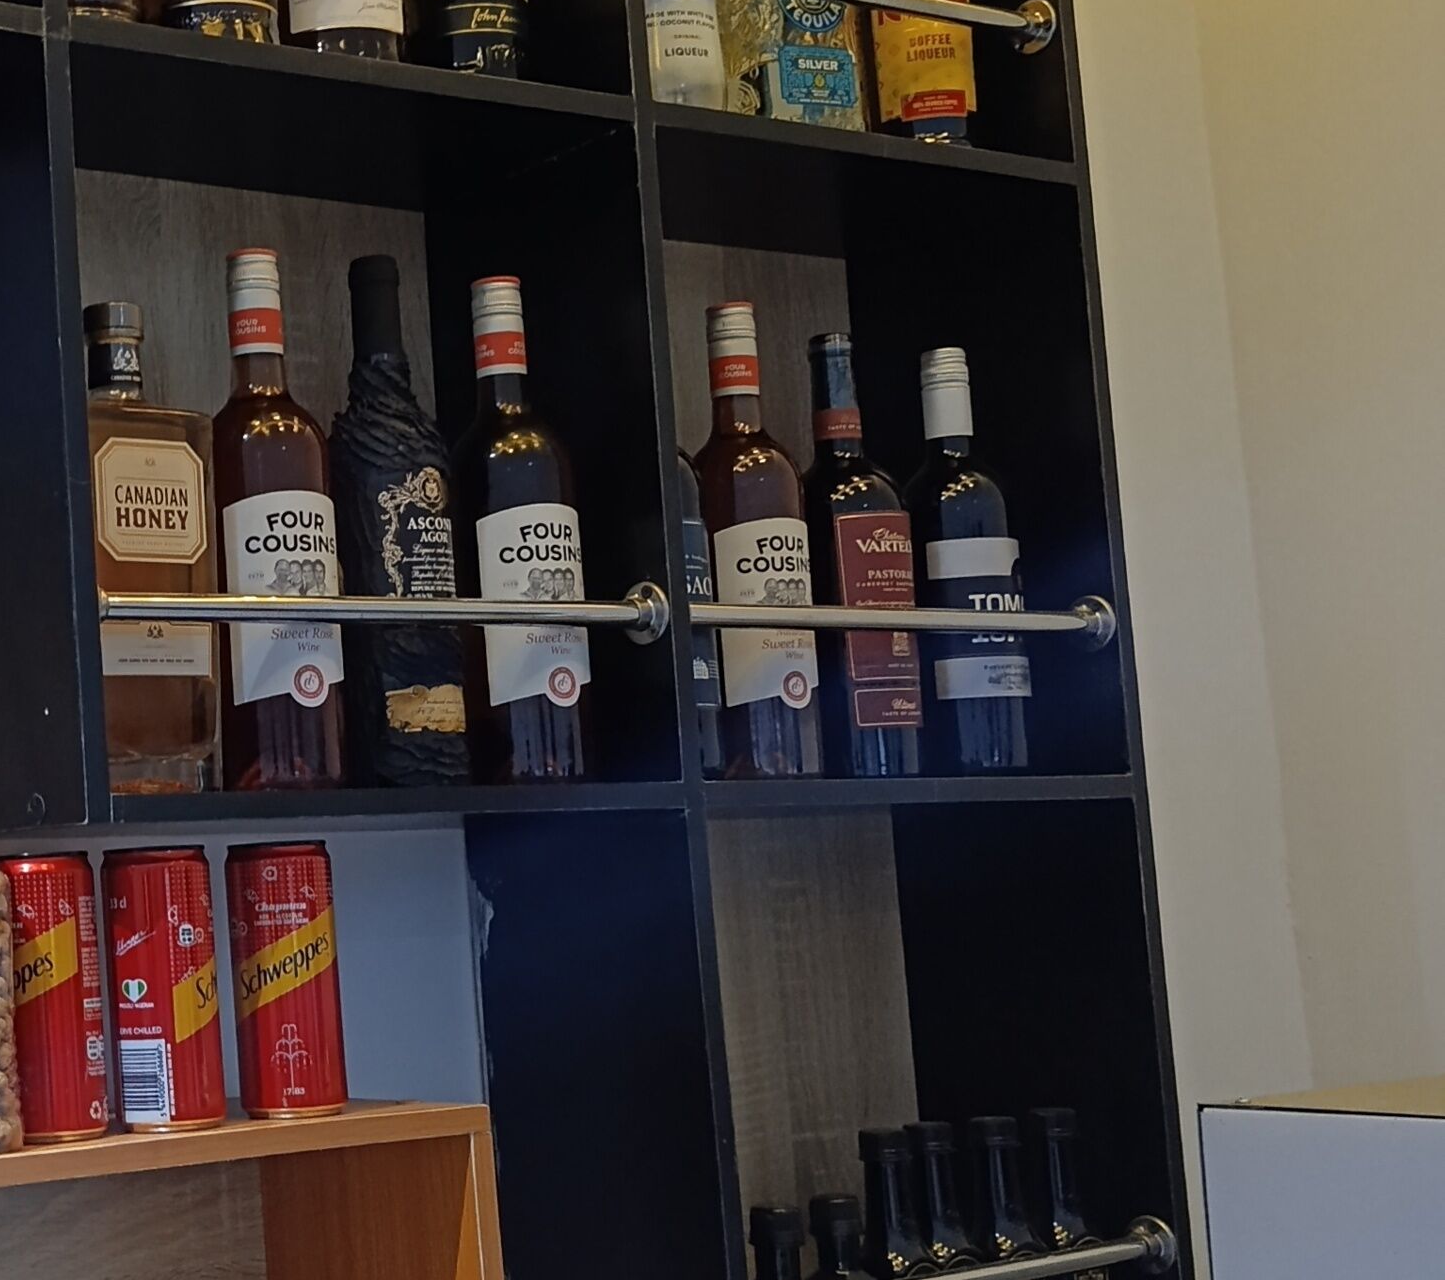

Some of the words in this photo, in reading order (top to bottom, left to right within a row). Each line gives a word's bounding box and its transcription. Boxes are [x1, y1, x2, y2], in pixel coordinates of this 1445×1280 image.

[664, 47, 709, 58] LIQUEUR
[797, 57, 840, 71] SILVER
[114, 484, 189, 507] CANADIAN
[115, 506, 190, 531] HONEY
[266, 510, 325, 532] FOUR
[420, 531, 450, 544] AGOR
[519, 522, 573, 544] FOUR
[244, 534, 336, 556] COUSINS
[499, 544, 583, 564] COUSINS
[755, 535, 804, 555] FOUR
[270, 626, 309, 641] Sweet
[525, 631, 562, 645] Sweet
[297, 641, 322, 653] Wine
[761, 638, 795, 651] Sweet
[241, 930, 330, 1000] Schweppes
